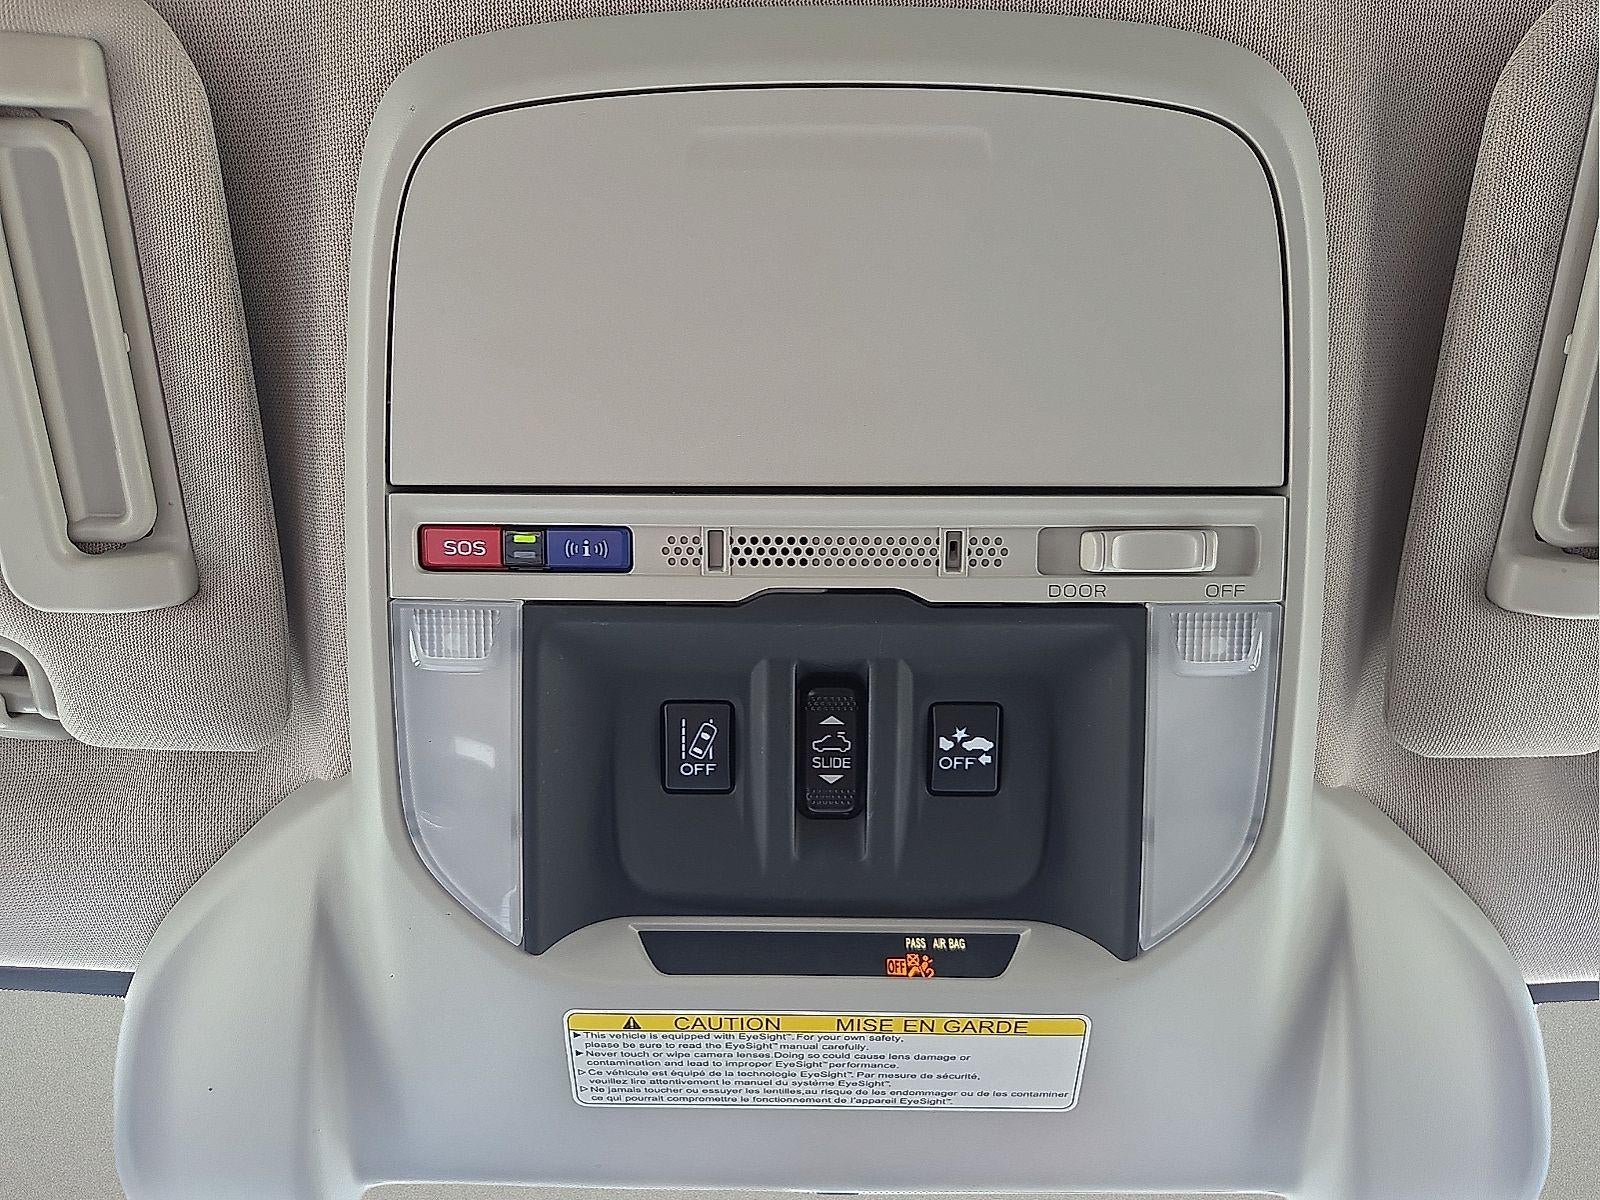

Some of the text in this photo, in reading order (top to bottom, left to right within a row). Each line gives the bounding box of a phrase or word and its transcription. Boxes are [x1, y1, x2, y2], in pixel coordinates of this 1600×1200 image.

[443, 540, 487, 556] SOS
[1048, 584, 1107, 598] DOOR
[1205, 584, 1246, 598] OFF
[680, 763, 717, 776] OFF
[812, 757, 851, 769] SLIDE
[938, 757, 976, 770] OFF
[905, 937, 966, 949] PASS AIR BAG
[888, 960, 905, 973] OFF
[674, 1017, 1029, 1034] CAUTION MISE EN GARDE
[661, 1033, 710, 1041] equipped
[914, 1054, 956, 1062] damage
[671, 1070, 705, 1078] équipé
